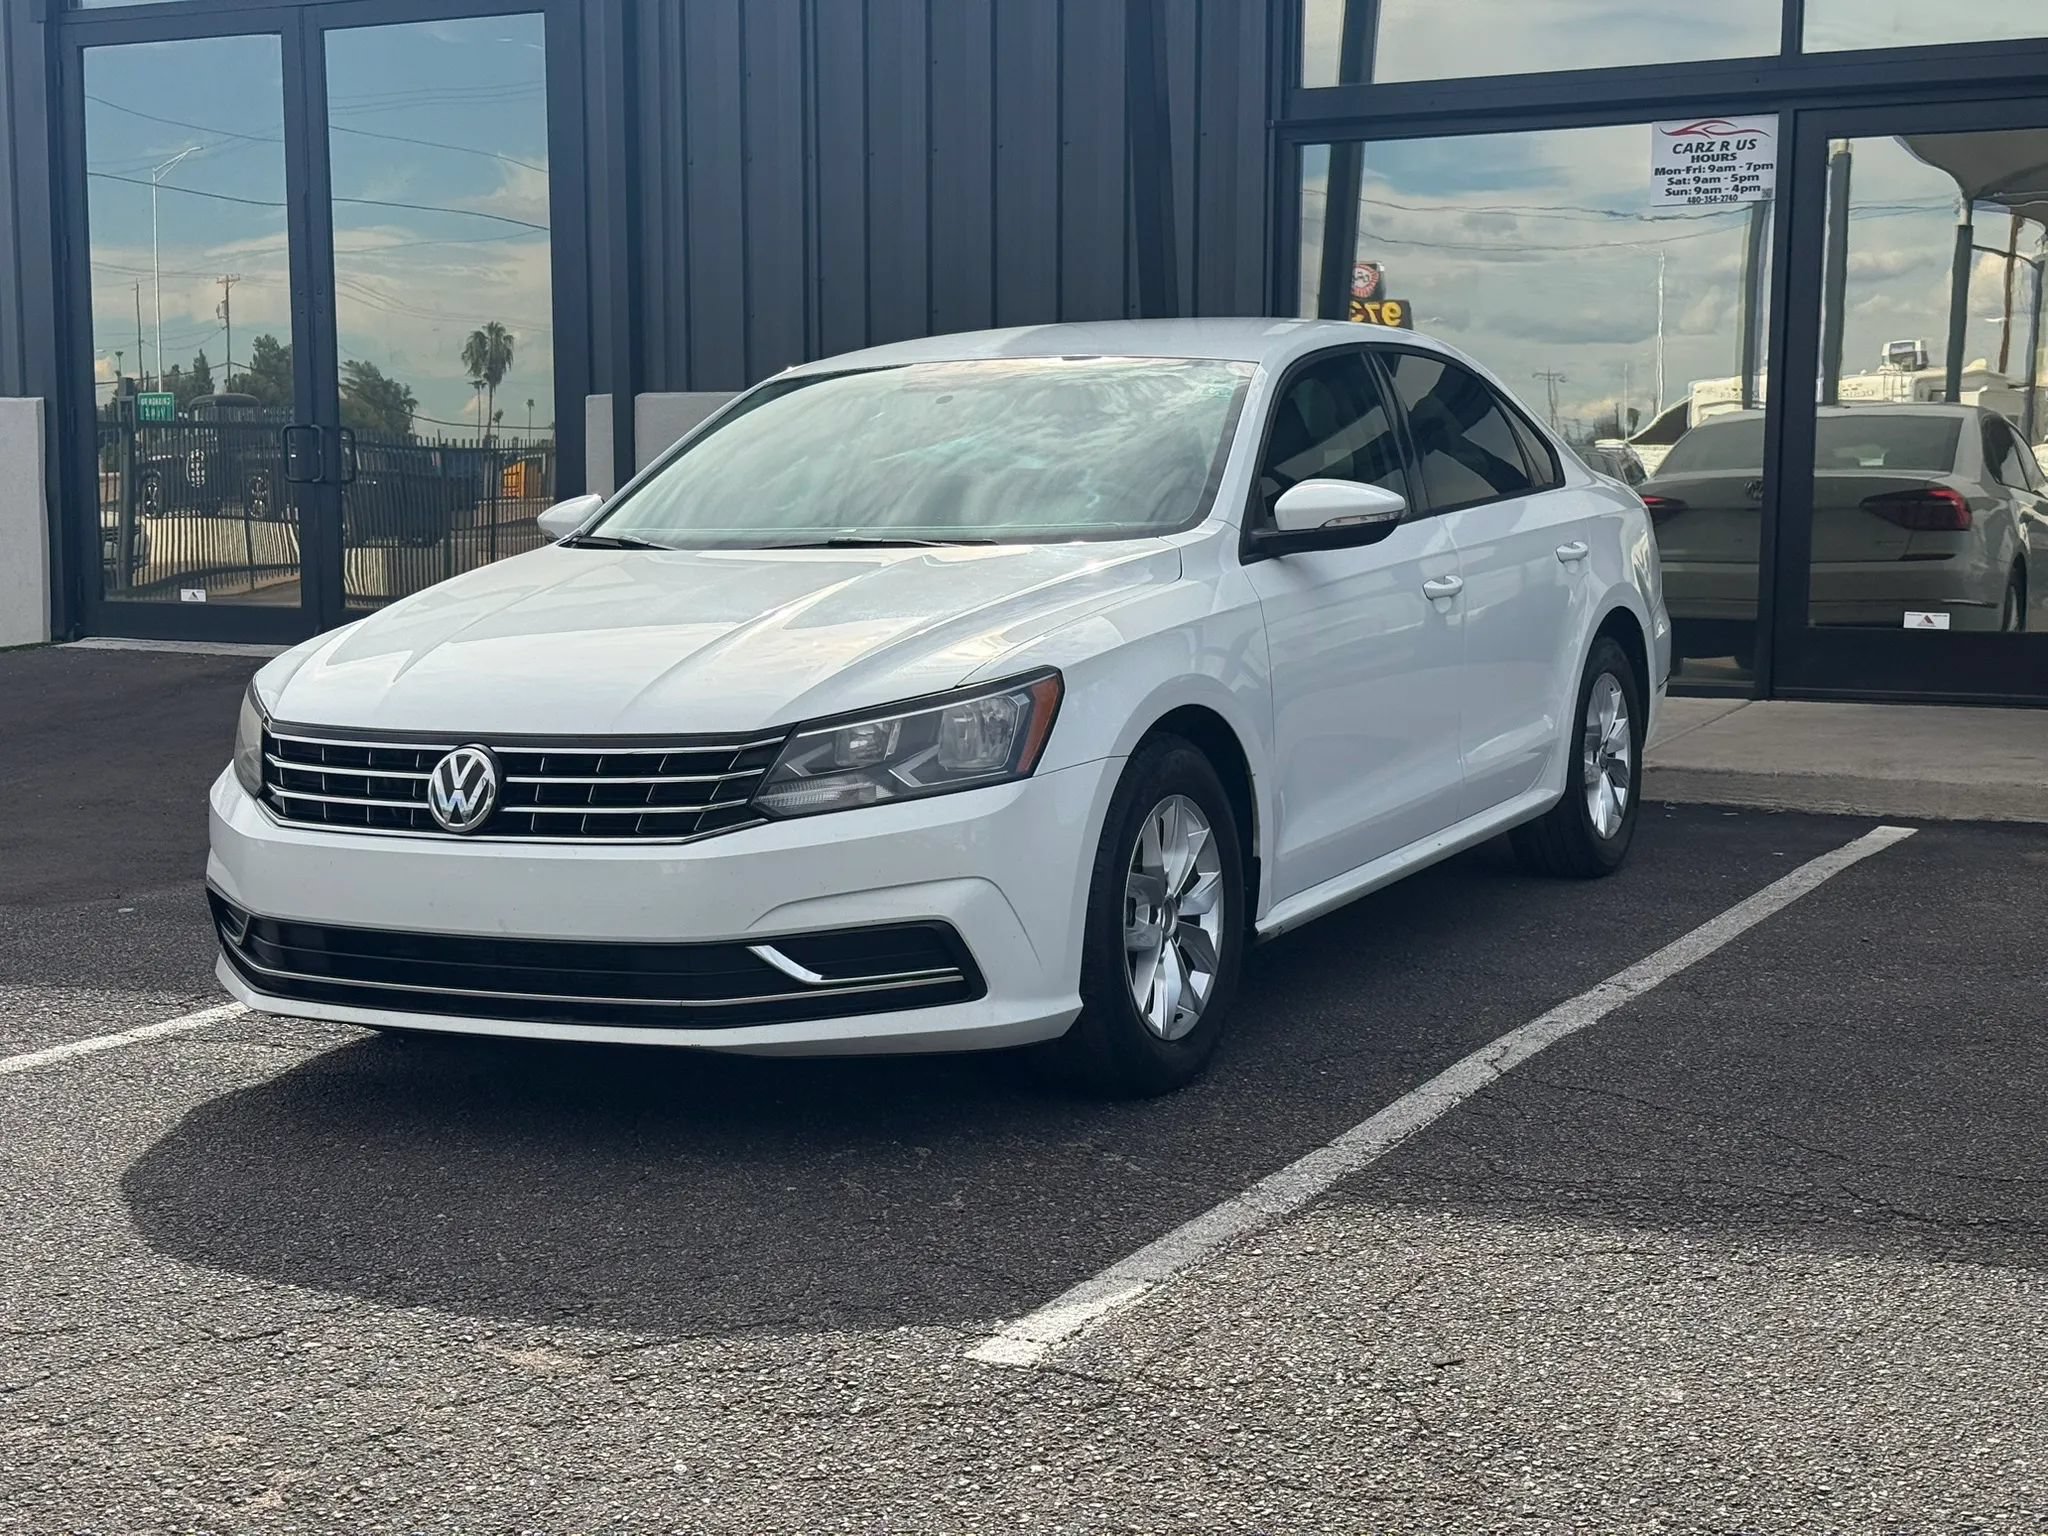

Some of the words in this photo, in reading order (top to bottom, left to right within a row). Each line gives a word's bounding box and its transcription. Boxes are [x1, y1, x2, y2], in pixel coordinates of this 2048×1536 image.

[1672, 141, 1716, 154] CARZ
[1719, 140, 1731, 152] R
[1735, 138, 1758, 151] US
[1690, 152, 1738, 163] HOURS
[1654, 165, 1706, 176] Mon-Fri:
[1707, 164, 1736, 173] 9am
[1745, 162, 1774, 171] 7pm
[1667, 175, 1691, 186] Sat:
[1692, 175, 1721, 184] 9am
[1730, 173, 1760, 183] 5pm
[1665, 187, 1692, 196] Sun:
[1693, 186, 1722, 195] 9am
[1732, 184, 1761, 194] 4pm
